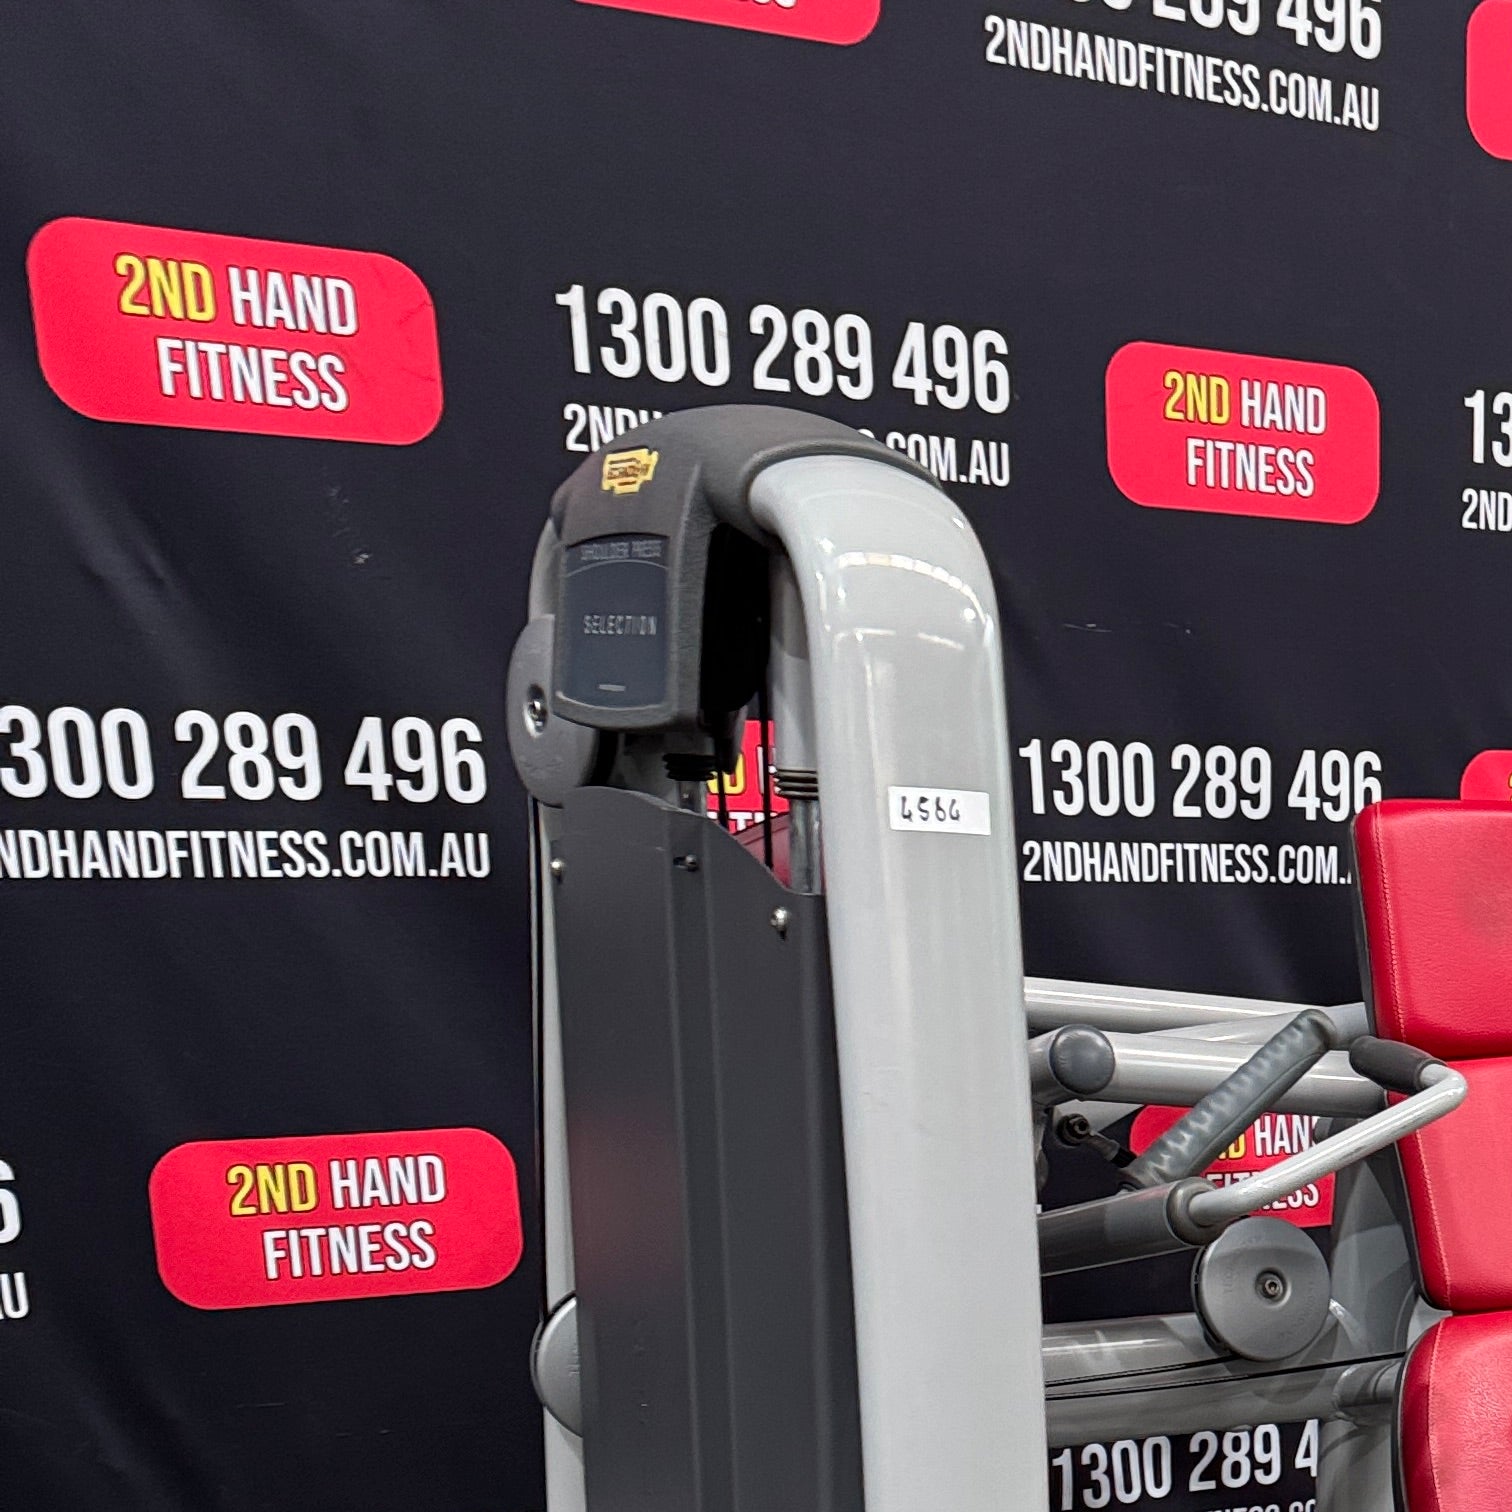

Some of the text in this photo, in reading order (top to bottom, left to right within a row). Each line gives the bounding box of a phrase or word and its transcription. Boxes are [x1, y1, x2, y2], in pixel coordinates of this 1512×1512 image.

[984, 15, 1381, 131] 2NDHANDFITNESS.COM.AU
[115, 254, 358, 336] 2ND HAND
[156, 337, 348, 412] FITNESS
[555, 284, 1010, 414] 1300 289 496
[1164, 371, 1326, 434] 2ND HAND
[1187, 437, 1315, 497] FITNESS
[0, 704, 487, 804] 300 289 496
[1018, 738, 1382, 822] 1300 289 496
[0, 829, 490, 879] NDHANDFITNESS.COM.AU
[227, 1155, 446, 1216] 2ND HAND
[263, 1220, 436, 1280] FITNESS
[1052, 1435, 1172, 1511] 1300
[1189, 1423, 1281, 1492] 289
